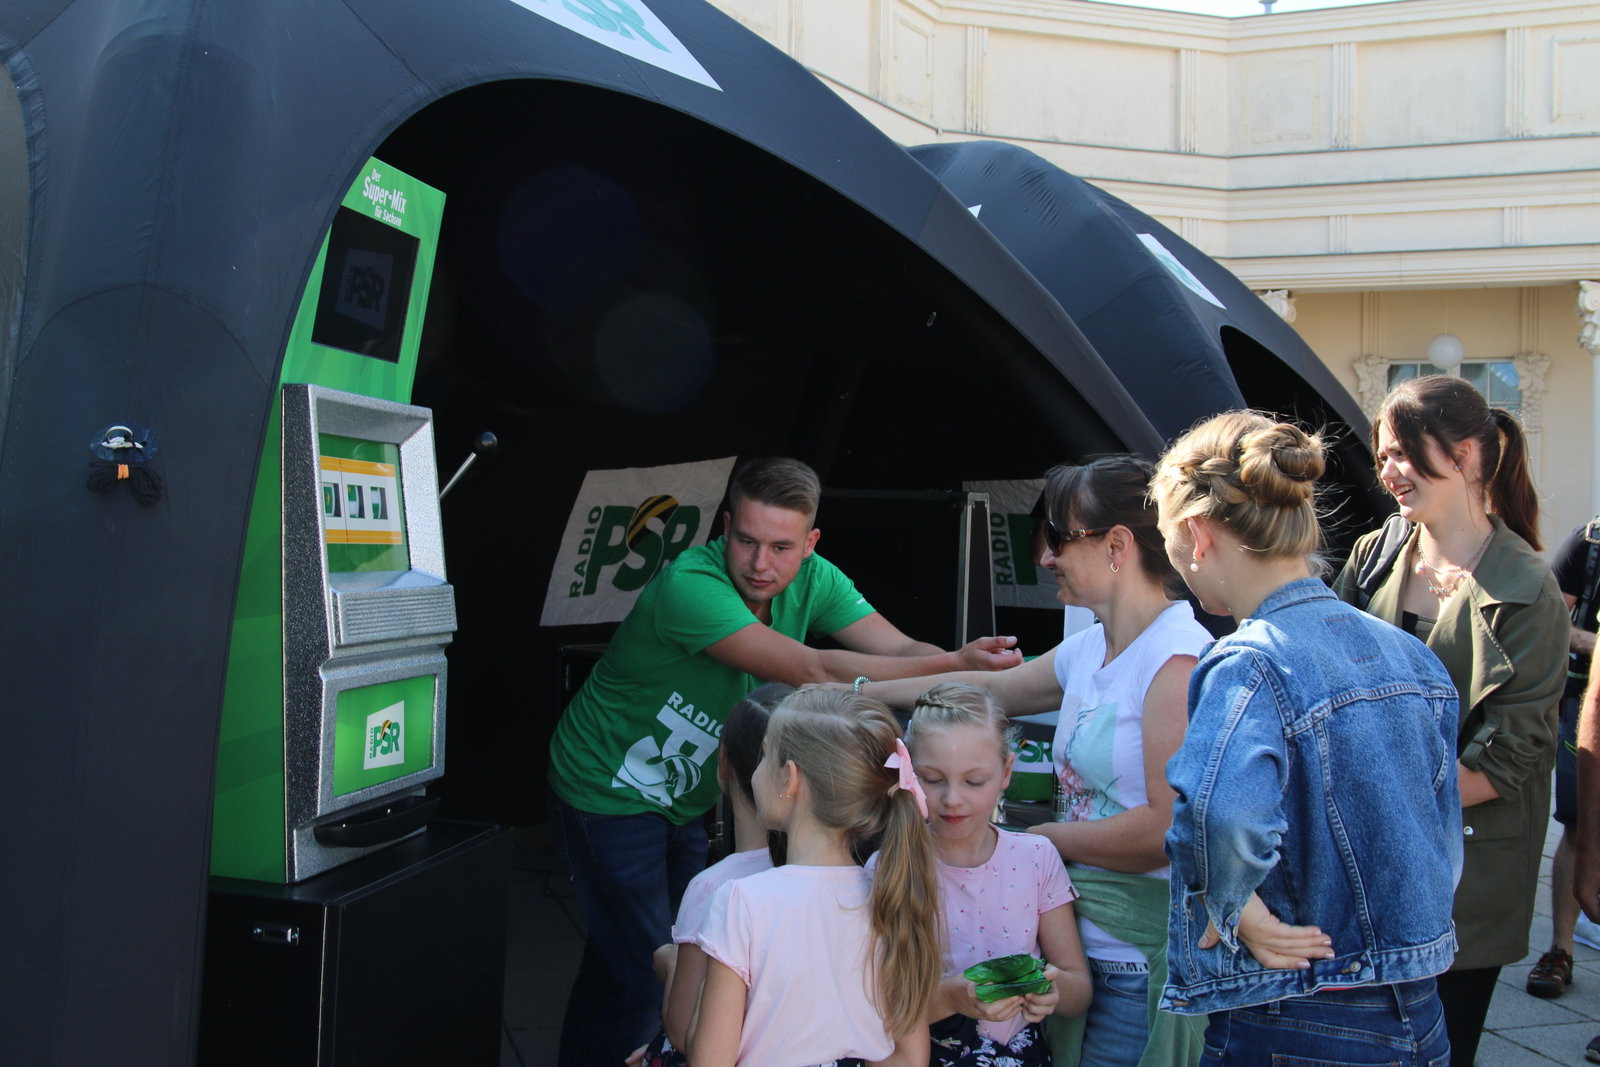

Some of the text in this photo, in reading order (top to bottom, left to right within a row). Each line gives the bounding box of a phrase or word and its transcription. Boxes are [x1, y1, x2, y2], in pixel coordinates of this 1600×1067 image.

[363, 175, 407, 214] Super-Mix
[371, 168, 382, 182] Der
[374, 205, 402, 227] für Sachsen
[349, 265, 385, 313] PSR
[568, 505, 603, 598] RADIO
[990, 512, 1016, 586] RADIO
[373, 719, 400, 758] PSR
